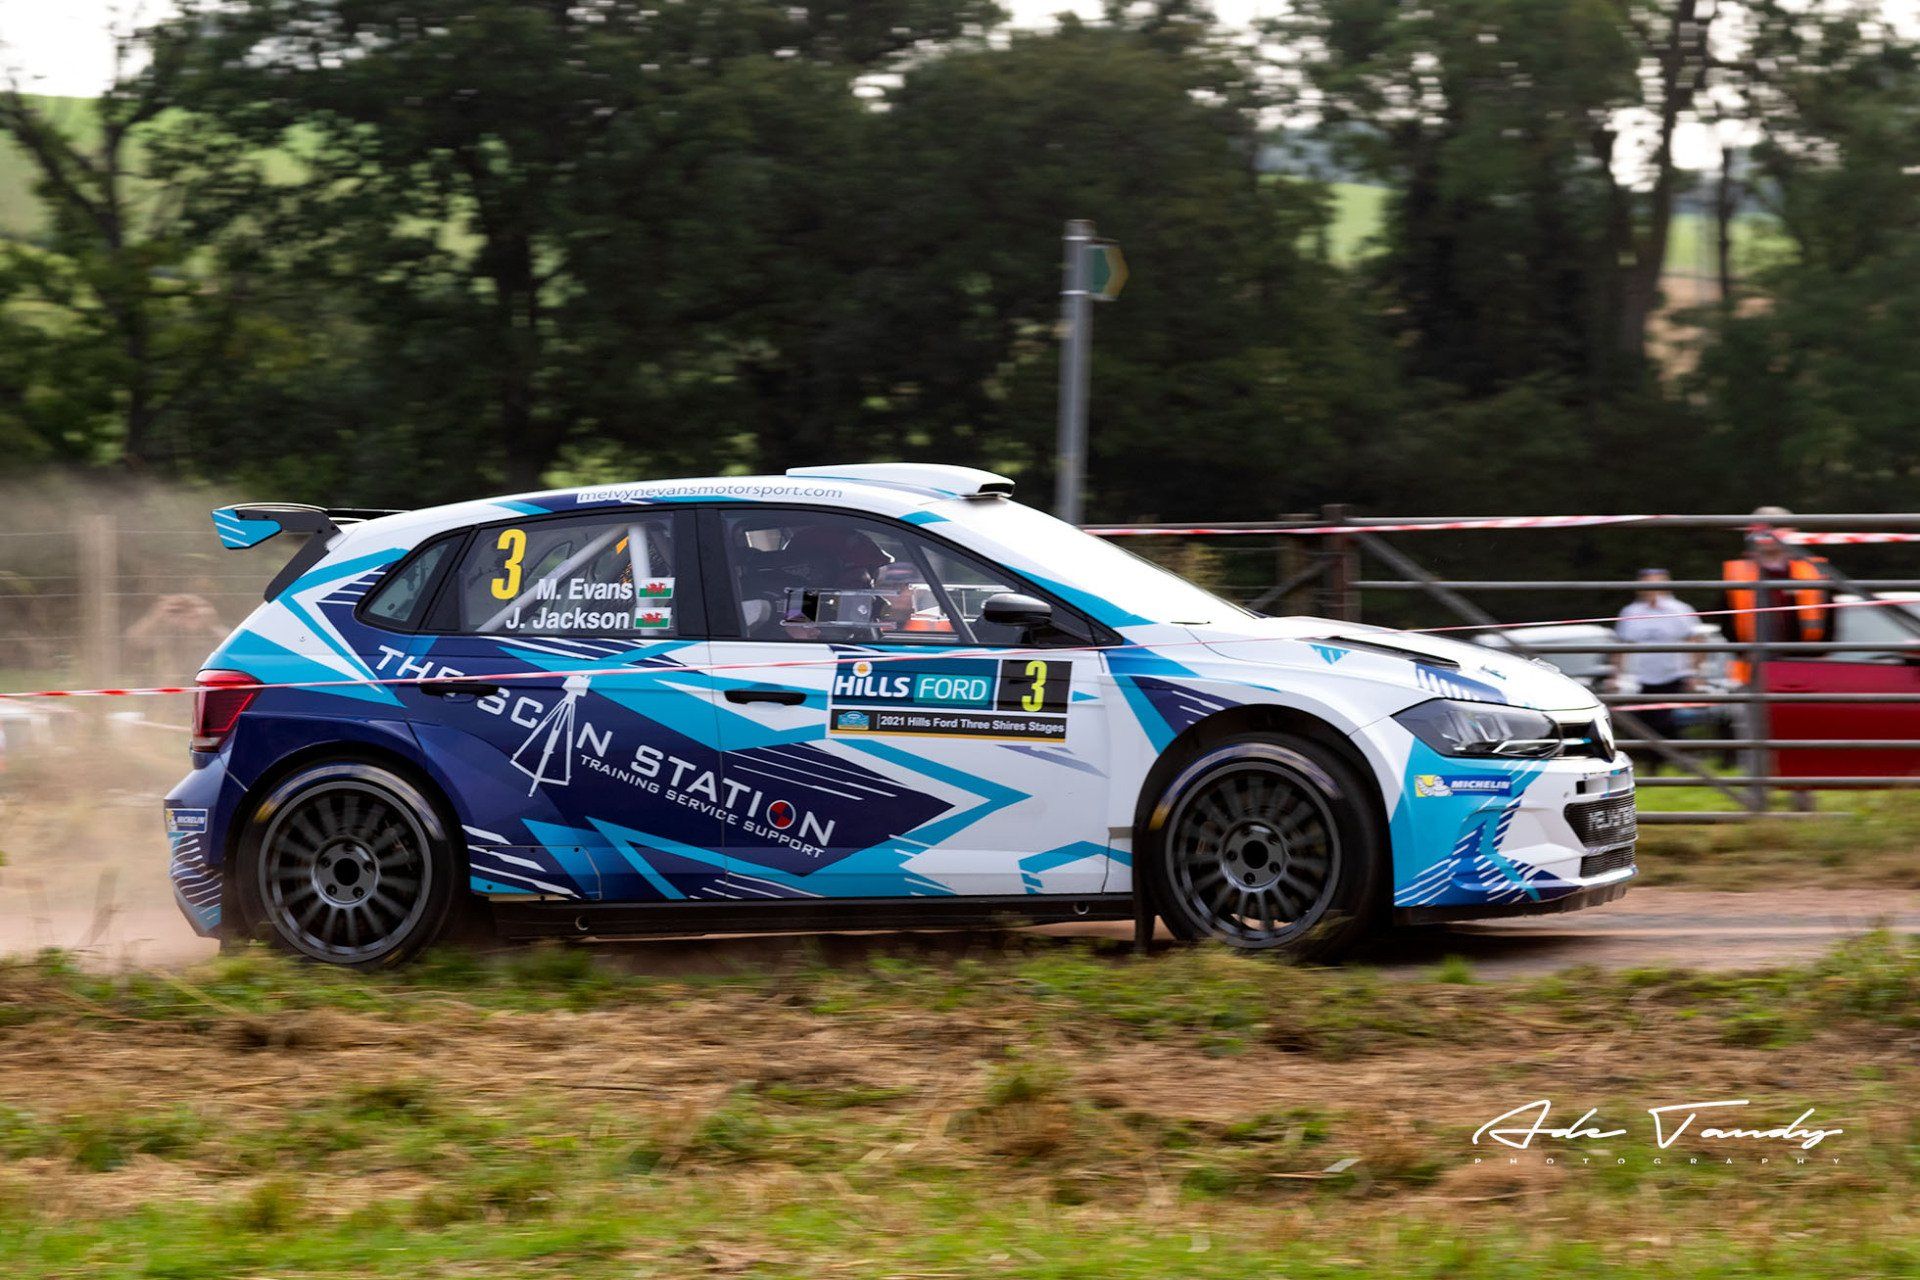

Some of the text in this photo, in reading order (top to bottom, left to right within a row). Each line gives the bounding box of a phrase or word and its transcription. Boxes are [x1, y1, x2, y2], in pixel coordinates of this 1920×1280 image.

[579, 484, 843, 501] melvynevansmotorsport.com
[491, 529, 527, 600] 3
[536, 578, 633, 600] M. Evans
[505, 607, 630, 630] J. Jackson
[918, 678, 988, 701] FORD
[1021, 660, 1048, 712] 3
[880, 716, 1065, 735] 2021 Hills Ford Three Shires Stages
[630, 744, 836, 847] STATION
[1451, 780, 1511, 789] MICHELIN
[580, 754, 826, 859] TRAINING SERVICE SUPPORT
